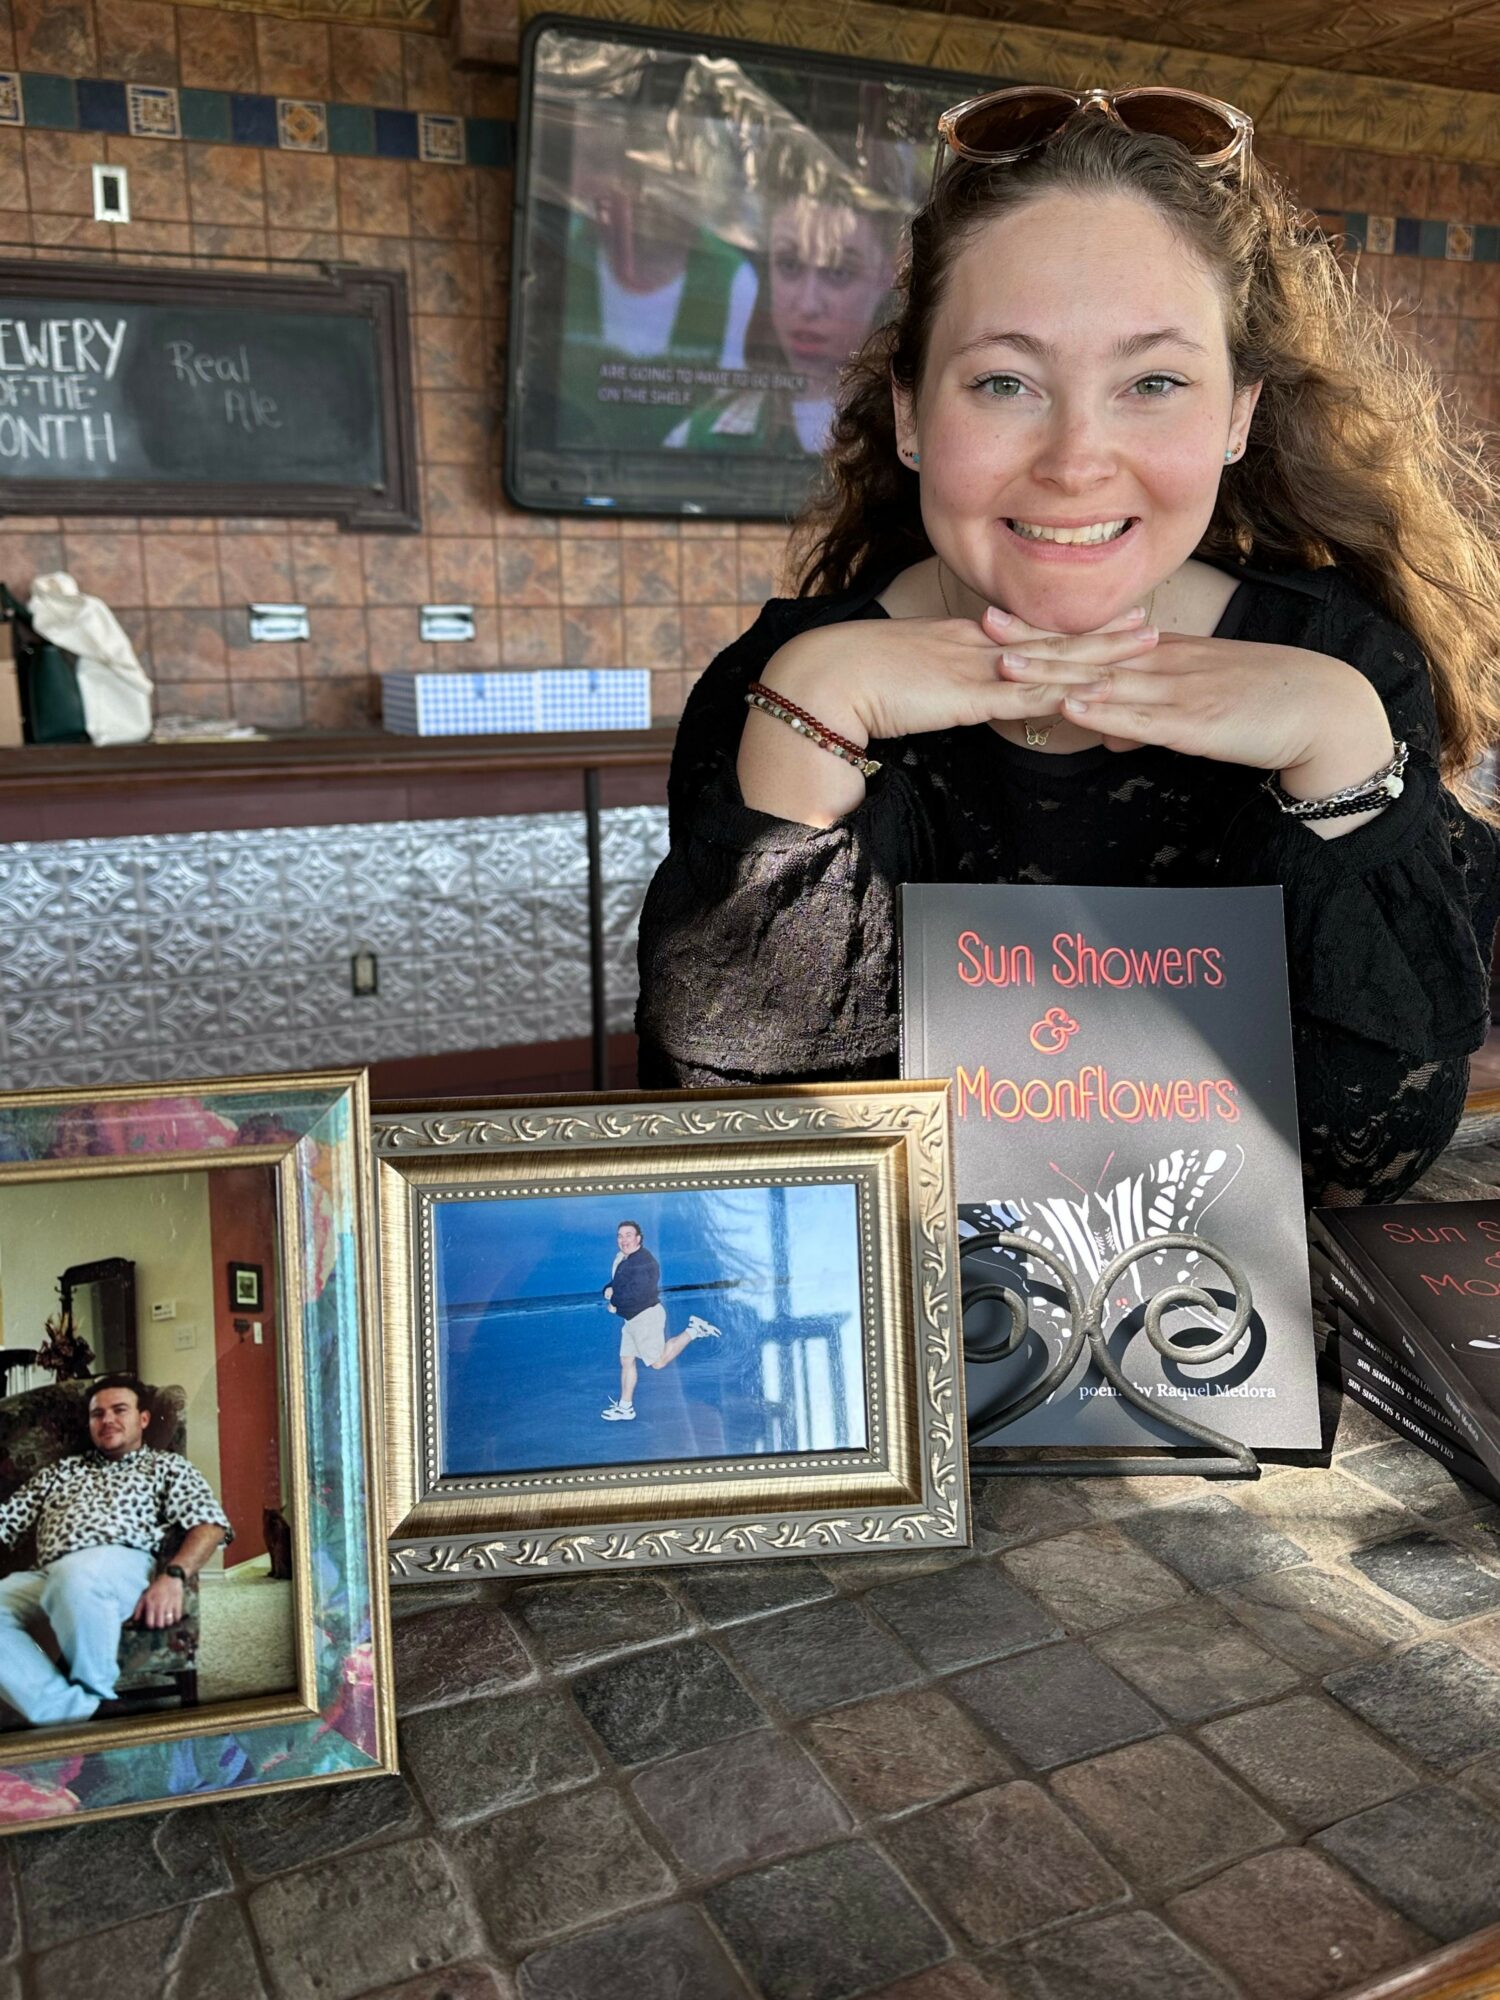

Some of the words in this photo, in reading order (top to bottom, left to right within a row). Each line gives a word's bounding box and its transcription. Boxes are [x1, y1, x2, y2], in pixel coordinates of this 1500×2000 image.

[165, 340, 251, 387] Real
[629, 366, 674, 382] GOING
[957, 930, 1034, 987] Sun
[1051, 932, 1226, 989] Showers
[1030, 1007, 1080, 1055] &
[956, 1064, 1241, 1123] Moonflowers
[1382, 1222, 1468, 1244] Sun
[1079, 1385, 1123, 1400] poem
[1156, 1383, 1210, 1400] Raquel
[1214, 1382, 1277, 1398] Medora
[1357, 1358, 1371, 1373] SUN
[1371, 1368, 1405, 1396] SHOWERS
[1347, 1378, 1361, 1393] SUN
[1361, 1388, 1394, 1416] SHOWERS
[1401, 1417, 1454, 1460] MOONFLOWERS
